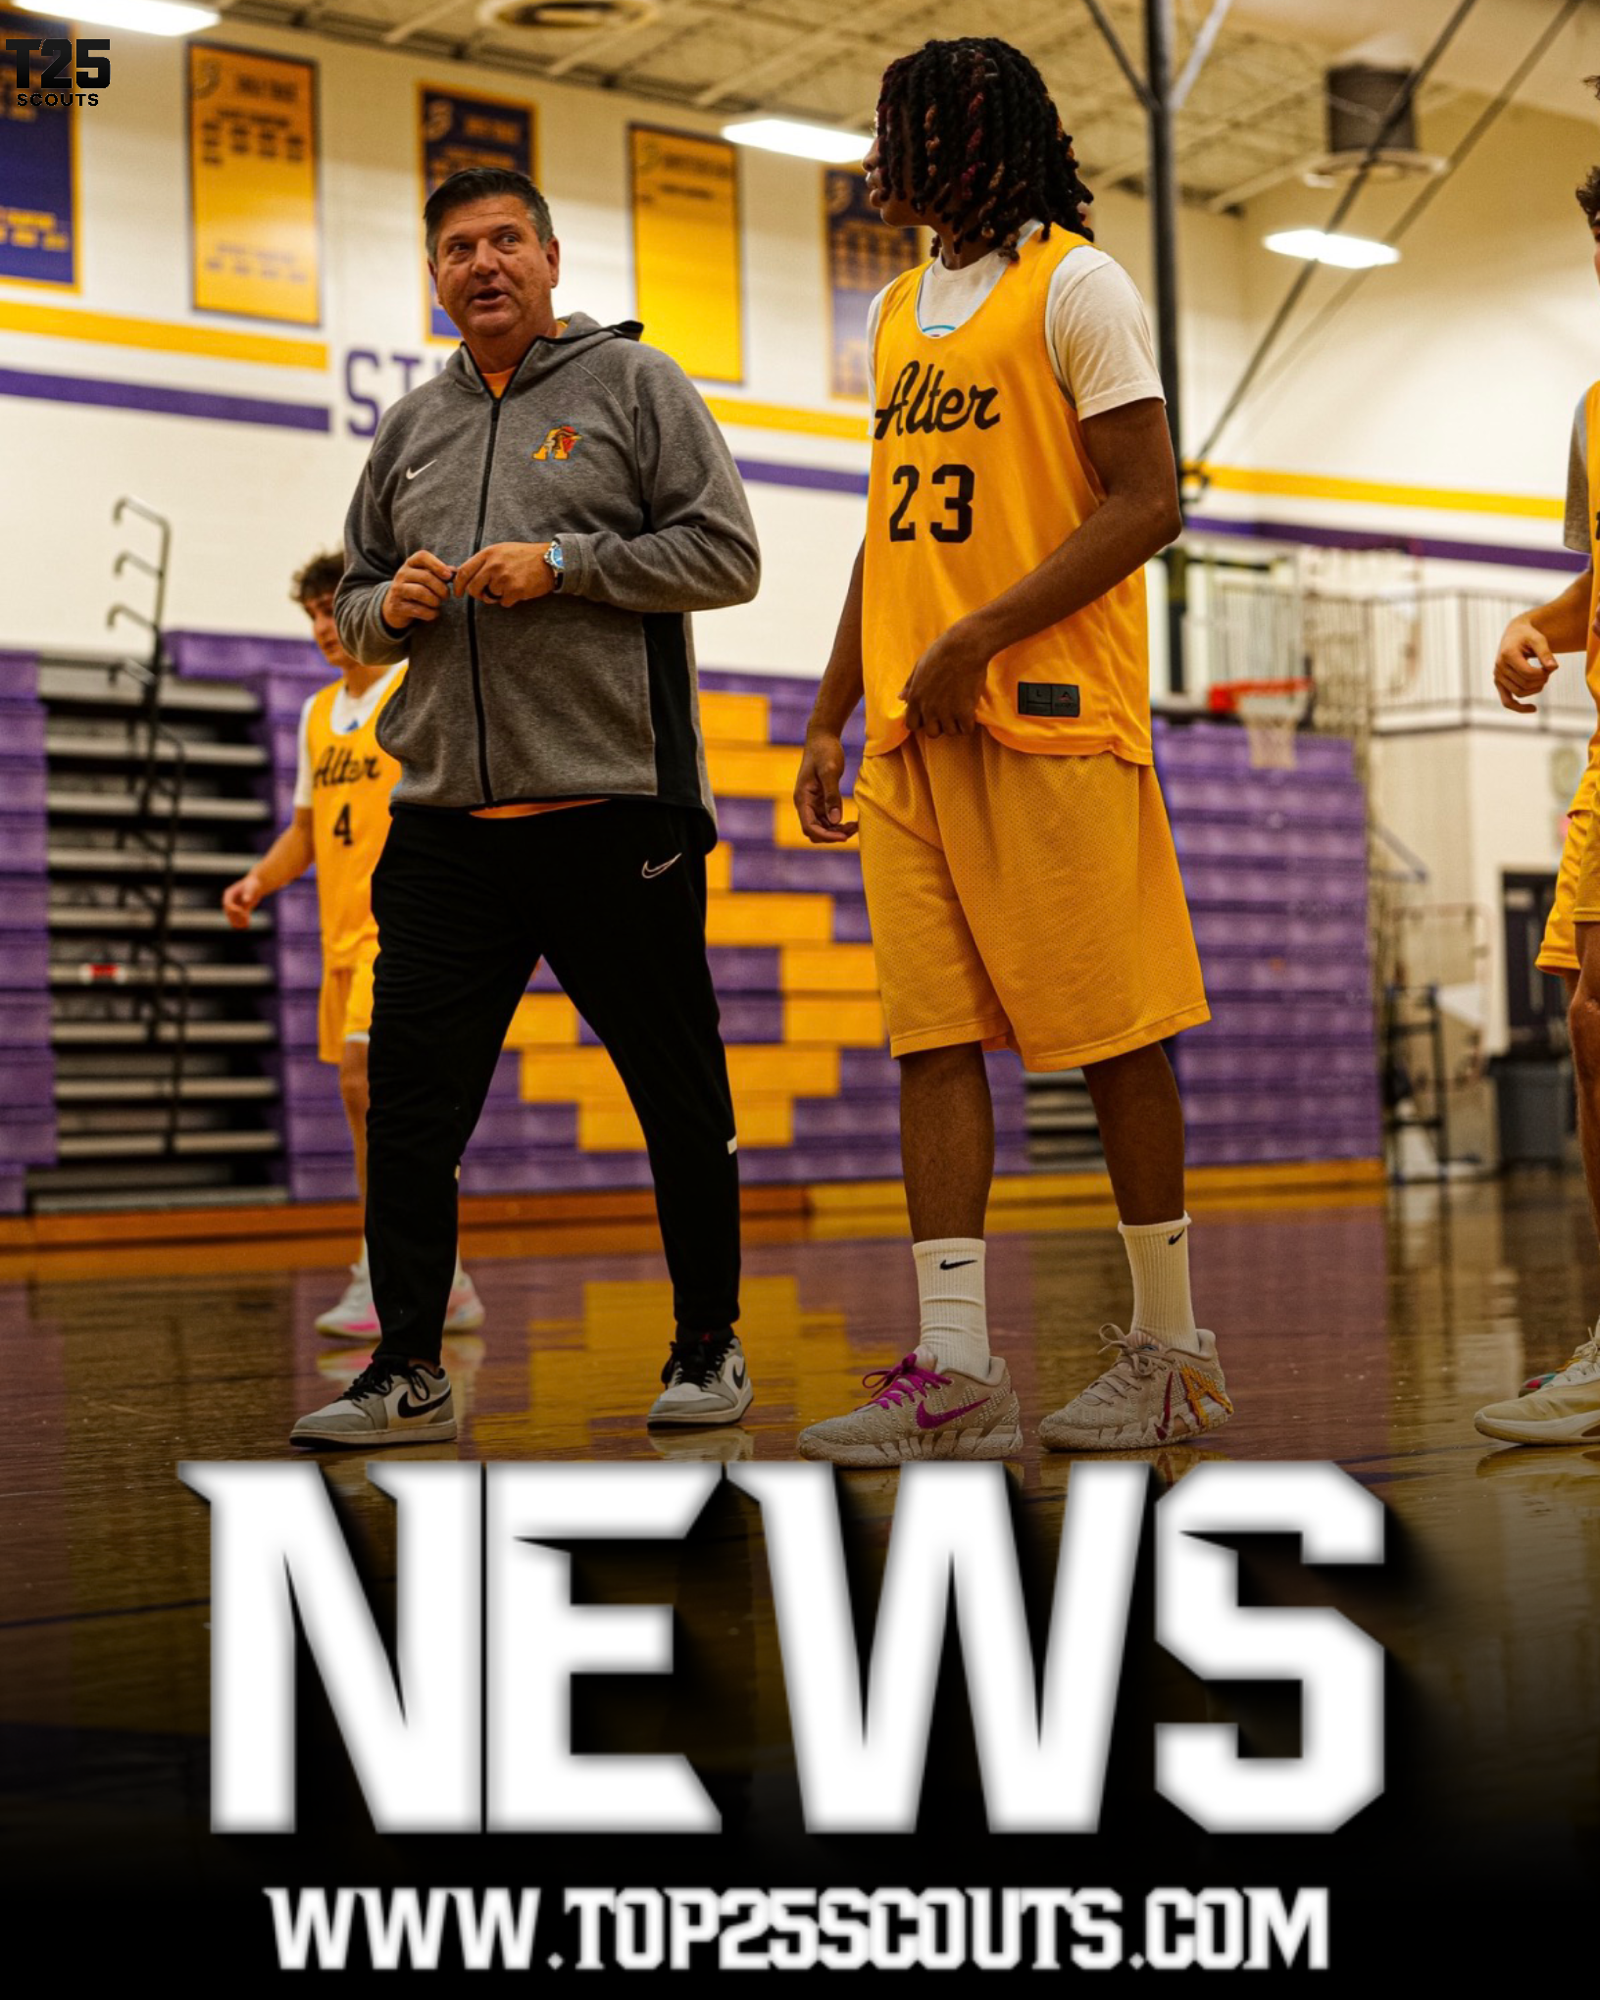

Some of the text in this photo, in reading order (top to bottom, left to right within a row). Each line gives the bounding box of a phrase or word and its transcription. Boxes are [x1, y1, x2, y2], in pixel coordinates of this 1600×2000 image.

[345, 350, 442, 437] ST
[874, 360, 1001, 440] Alter
[889, 463, 975, 544] 23
[312, 745, 382, 788] Alter
[333, 803, 353, 847] 4
